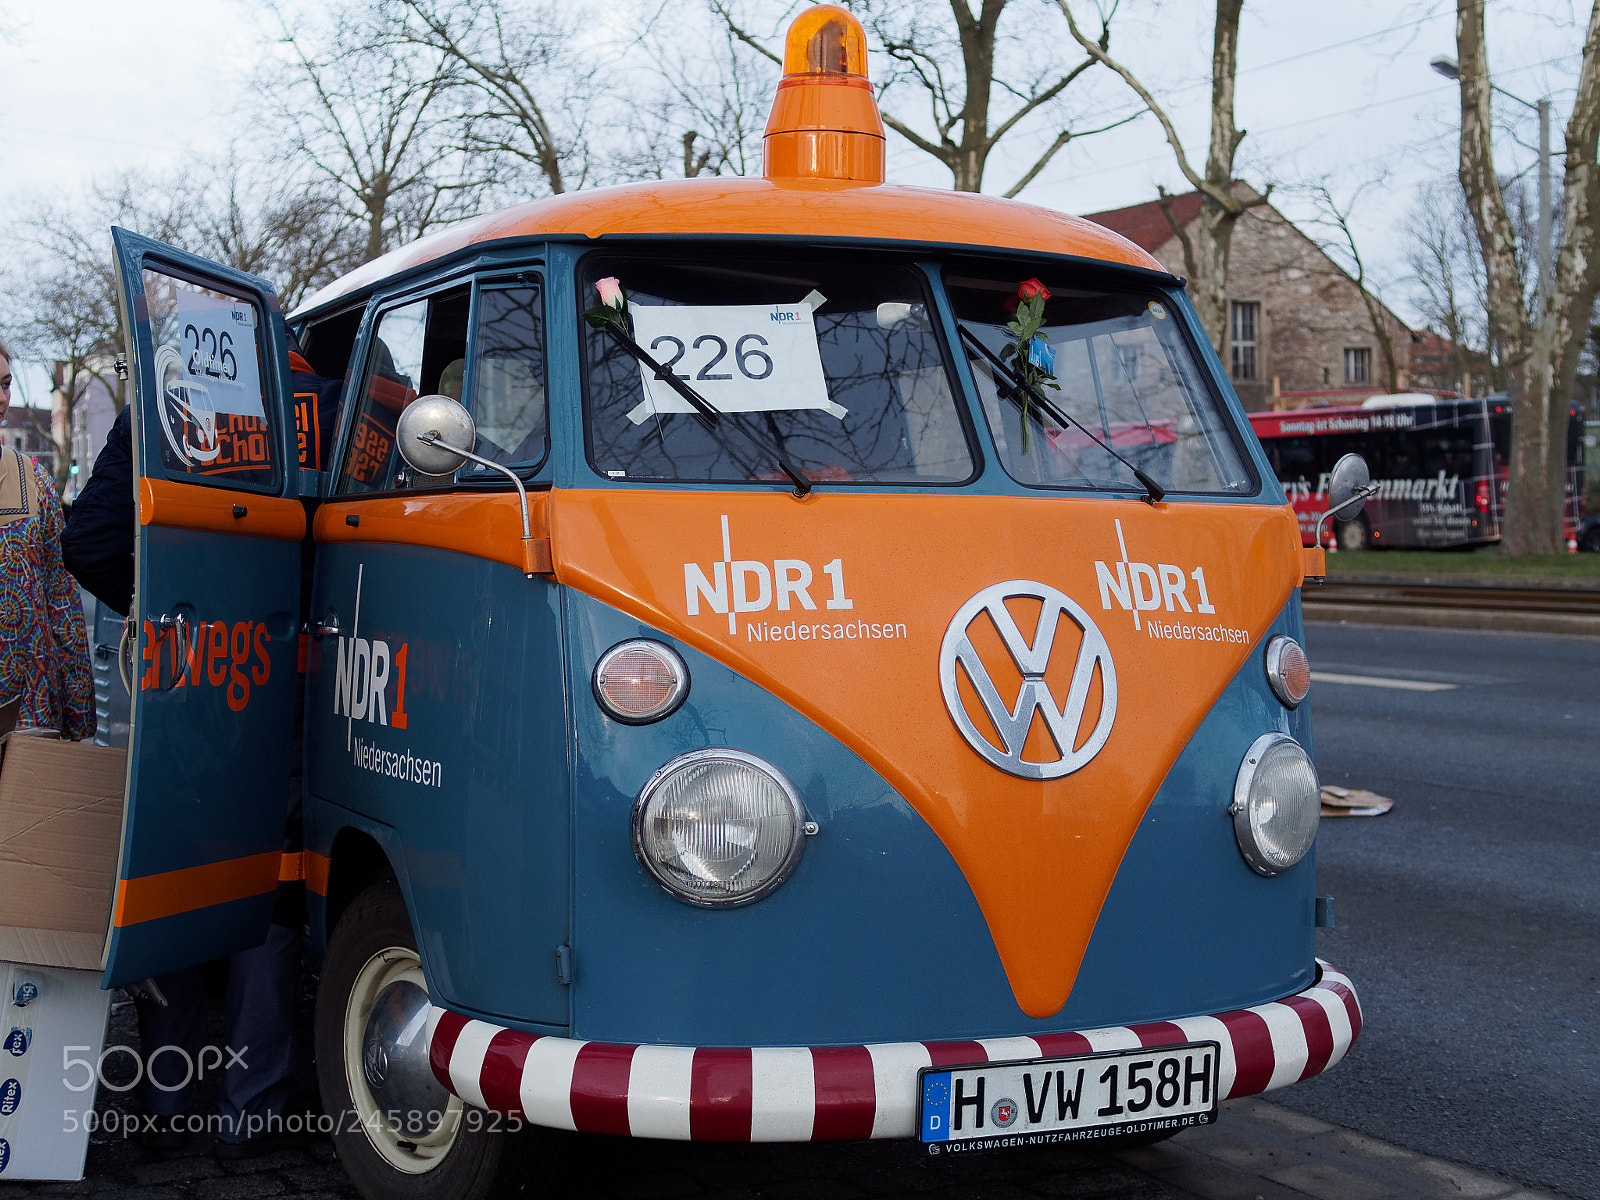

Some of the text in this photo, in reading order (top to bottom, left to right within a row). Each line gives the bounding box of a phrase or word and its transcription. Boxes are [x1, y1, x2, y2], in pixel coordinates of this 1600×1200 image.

[184, 324, 237, 381] 226
[192, 348, 231, 373] Oldtimer
[650, 333, 774, 380] 226
[747, 619, 907, 642] Niedersachsen
[1146, 619, 1250, 645] Niedersachsen
[353, 736, 442, 788] Niedersachsen
[1, 1080, 18, 1113] Ritex
[953, 1076, 985, 1131] H
[1023, 1068, 1085, 1124] VW
[1097, 1053, 1211, 1117] 158H
[929, 1115, 941, 1130] D
[945, 1116, 1195, 1153] VOLKSWAGEN-NUTZFAHRZEUGE-OLDTIMER.DE
